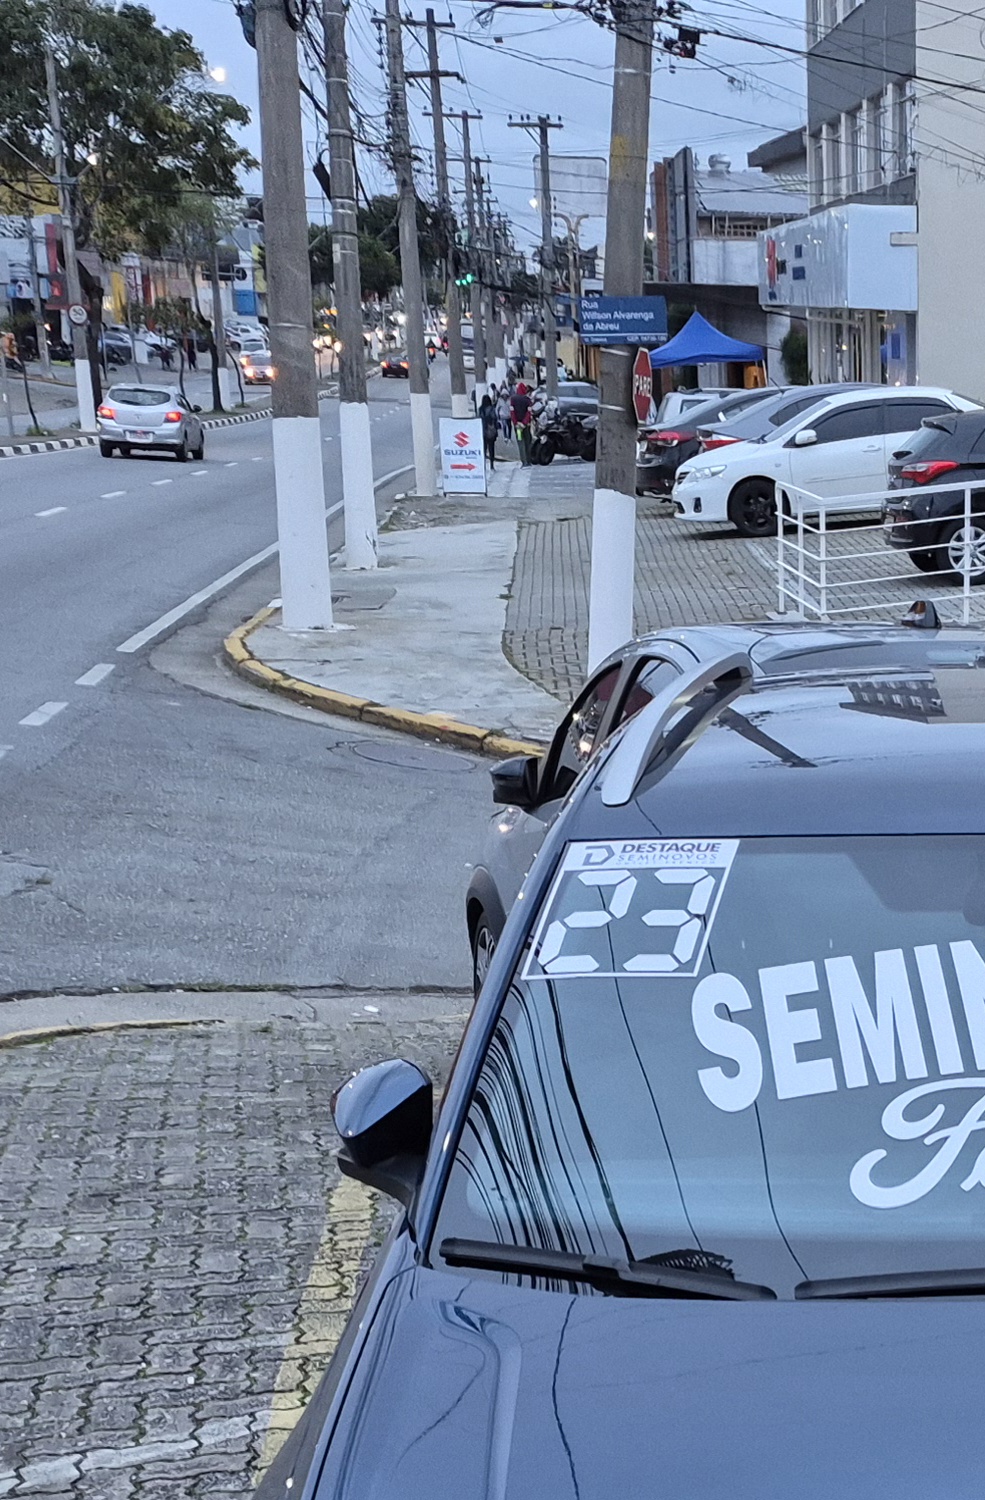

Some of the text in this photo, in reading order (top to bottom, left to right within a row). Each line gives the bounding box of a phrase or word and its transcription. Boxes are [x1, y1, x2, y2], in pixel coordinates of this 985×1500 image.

[581, 300, 599, 309] Rua
[613, 311, 654, 321] Alvarenga
[595, 322, 620, 331] Abreu
[635, 374, 651, 397] PARE
[620, 842, 722, 854] DESTAQUE
[617, 853, 718, 862] SEMINOVOS
[537, 868, 716, 974] 23
